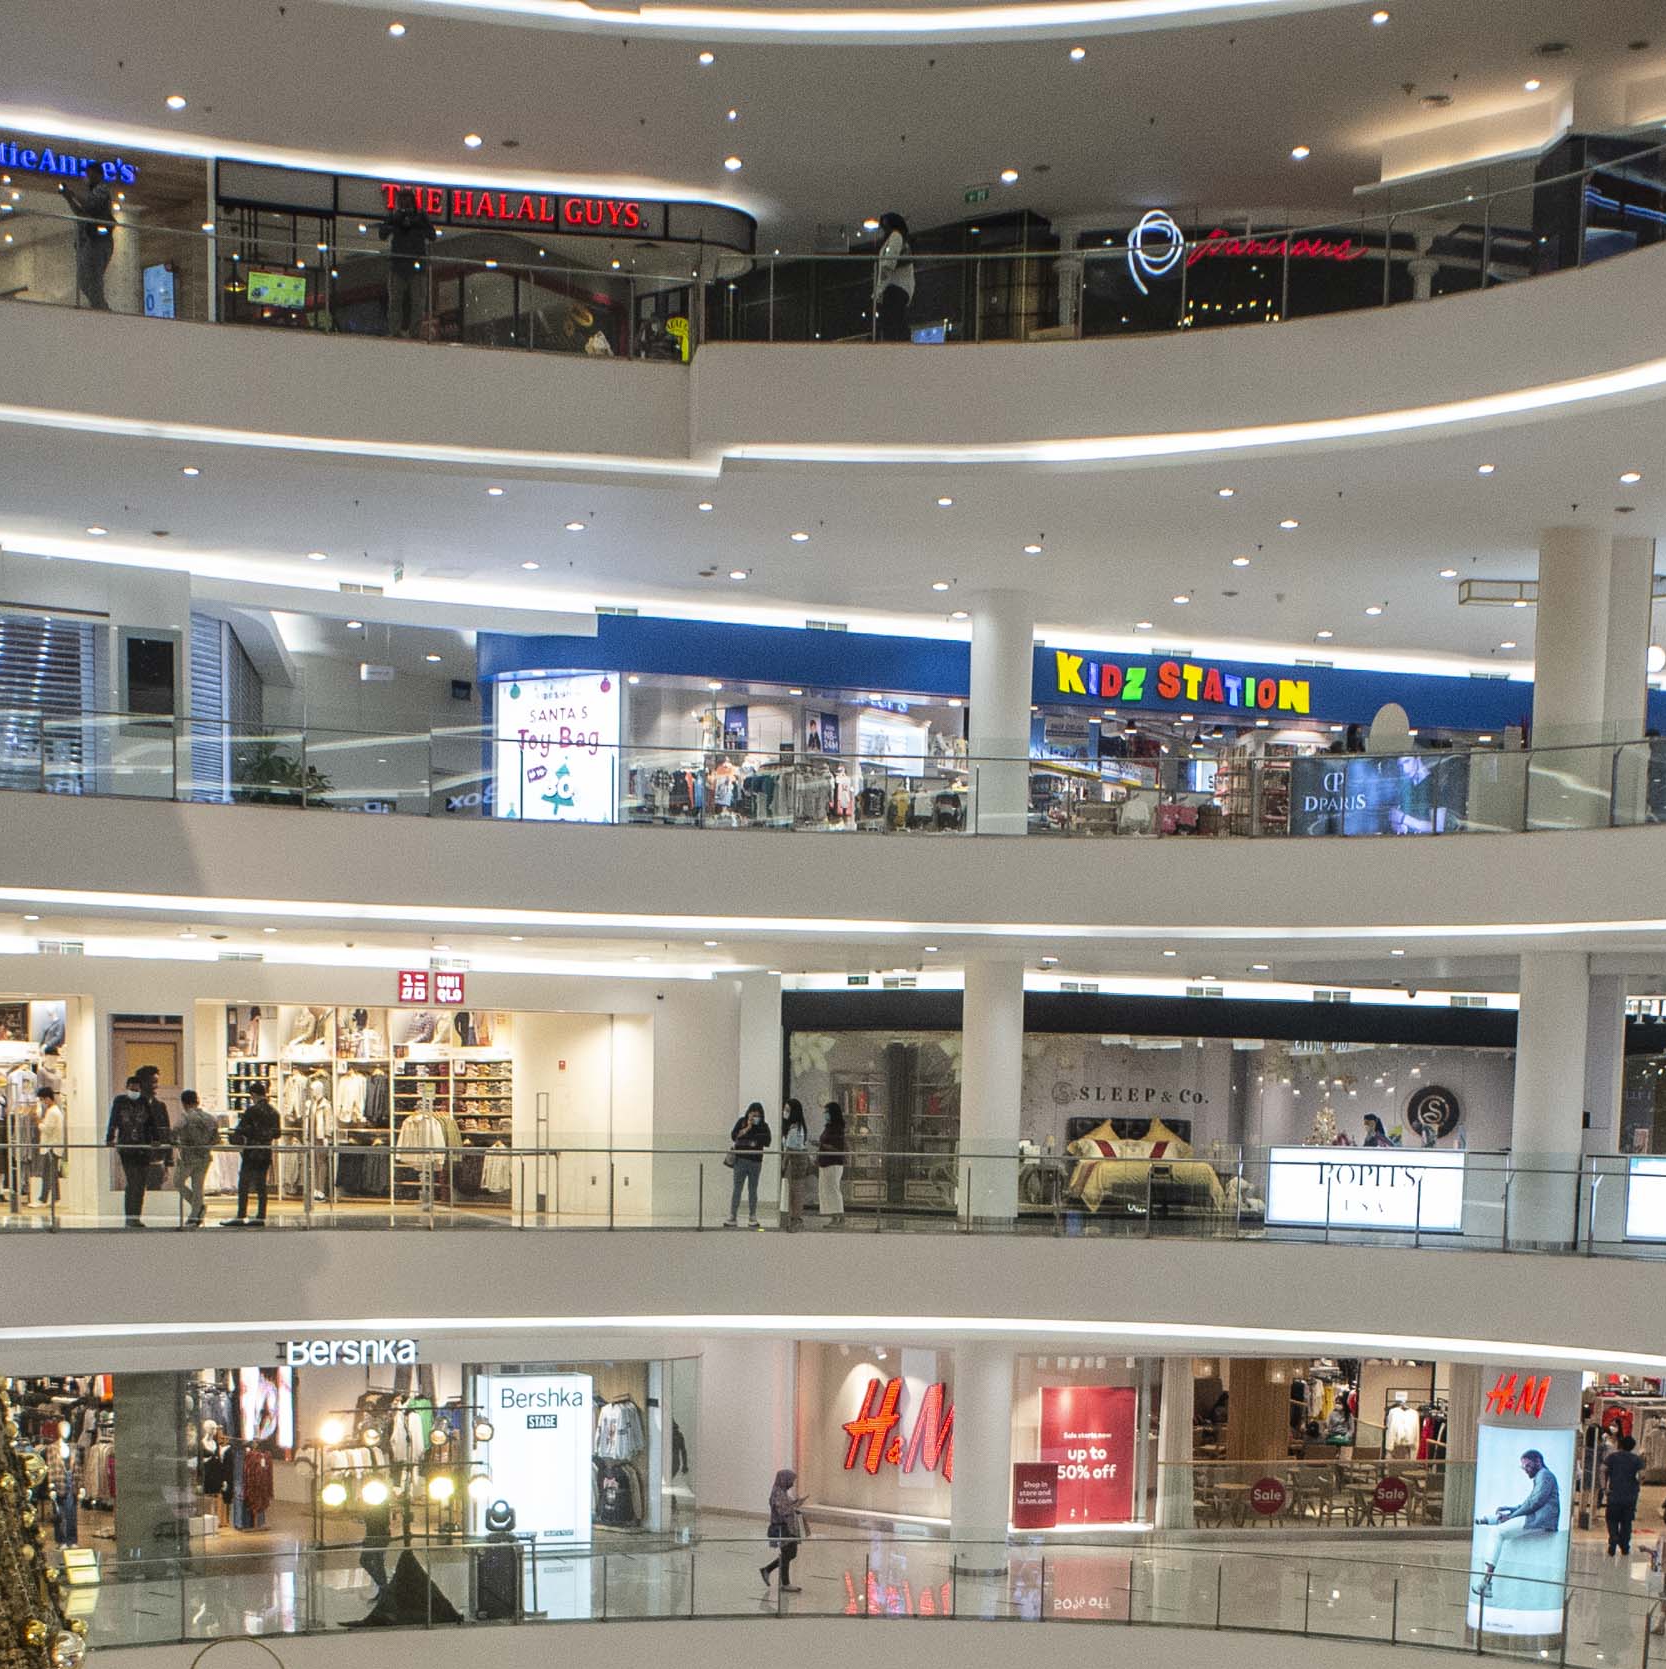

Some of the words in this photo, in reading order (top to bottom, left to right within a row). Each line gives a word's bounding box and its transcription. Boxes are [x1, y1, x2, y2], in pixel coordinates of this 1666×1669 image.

[453, 190, 555, 222] HALAL
[1055, 650, 1148, 701] KIDZ
[1157, 661, 1310, 714] STATION
[559, 726, 600, 755] Bag
[1304, 794, 1367, 812] DPARIS
[436, 975, 460, 988] UNI
[436, 988, 462, 1002] QLO
[1079, 1087, 1156, 1101] SLEEP
[500, 1388, 584, 1409] Bershka
[1486, 1372, 1551, 1420] H&M
[528, 1416, 556, 1428] STAGE
[1063, 1431, 1077, 1440] Sale
[1067, 1448, 1087, 1463] up
[1089, 1446, 1107, 1460] to
[1057, 1465, 1090, 1479] 50%
[1092, 1464, 1117, 1479] off
[1253, 1488, 1282, 1501] Sale
[1377, 1487, 1406, 1500] Sale
